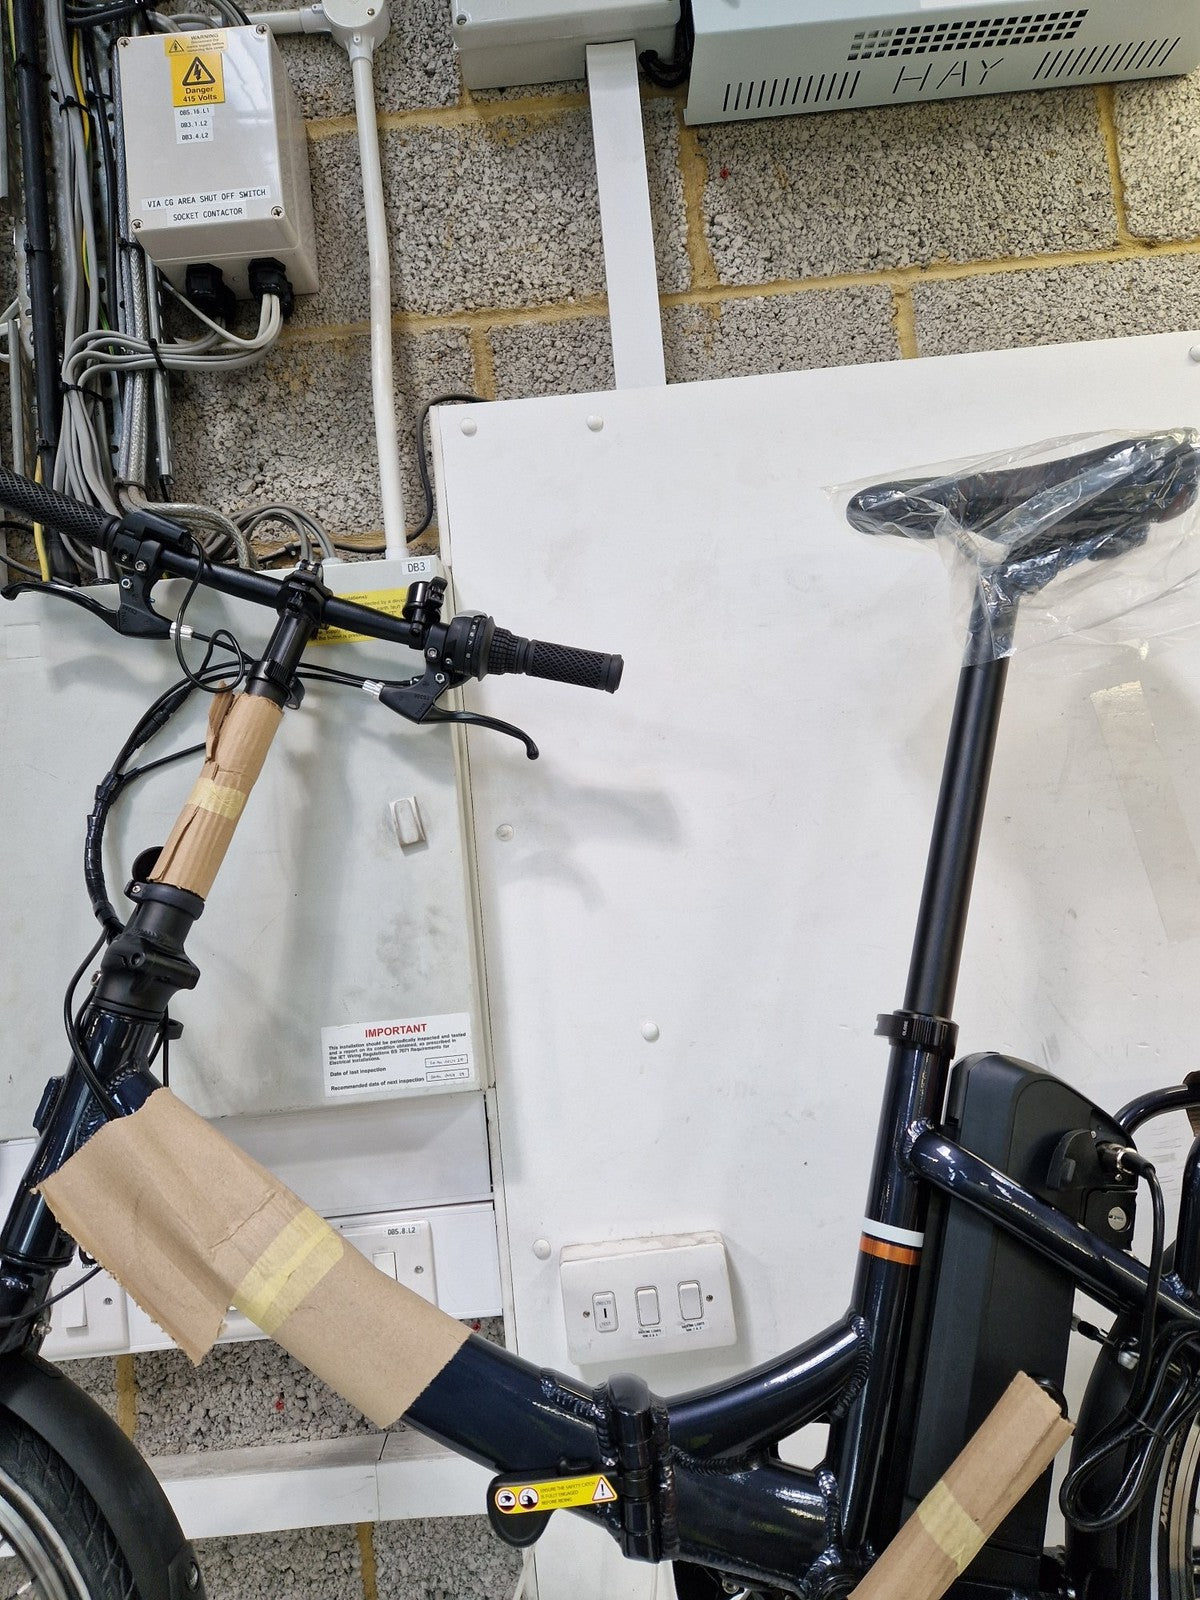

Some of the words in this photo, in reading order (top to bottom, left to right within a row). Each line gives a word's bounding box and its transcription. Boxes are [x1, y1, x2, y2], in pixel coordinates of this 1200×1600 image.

[892, 58, 1004, 94] HAY
[185, 86, 213, 95] Danger
[148, 200, 160, 208] VIA
[178, 196, 196, 205] AREA
[200, 194, 217, 203] SHUT
[221, 192, 234, 200] OFF
[238, 188, 266, 198] SWITCH
[172, 212, 199, 222] SOCKET
[202, 208, 243, 218] CONTACTOR
[407, 562, 426, 572] DB3
[365, 1023, 427, 1038] IMPORTANT
[426, 1038, 451, 1046] prescribed
[360, 1066, 386, 1074] inspection
[330, 1082, 368, 1091] Recommended
[398, 1076, 425, 1084] inspection
